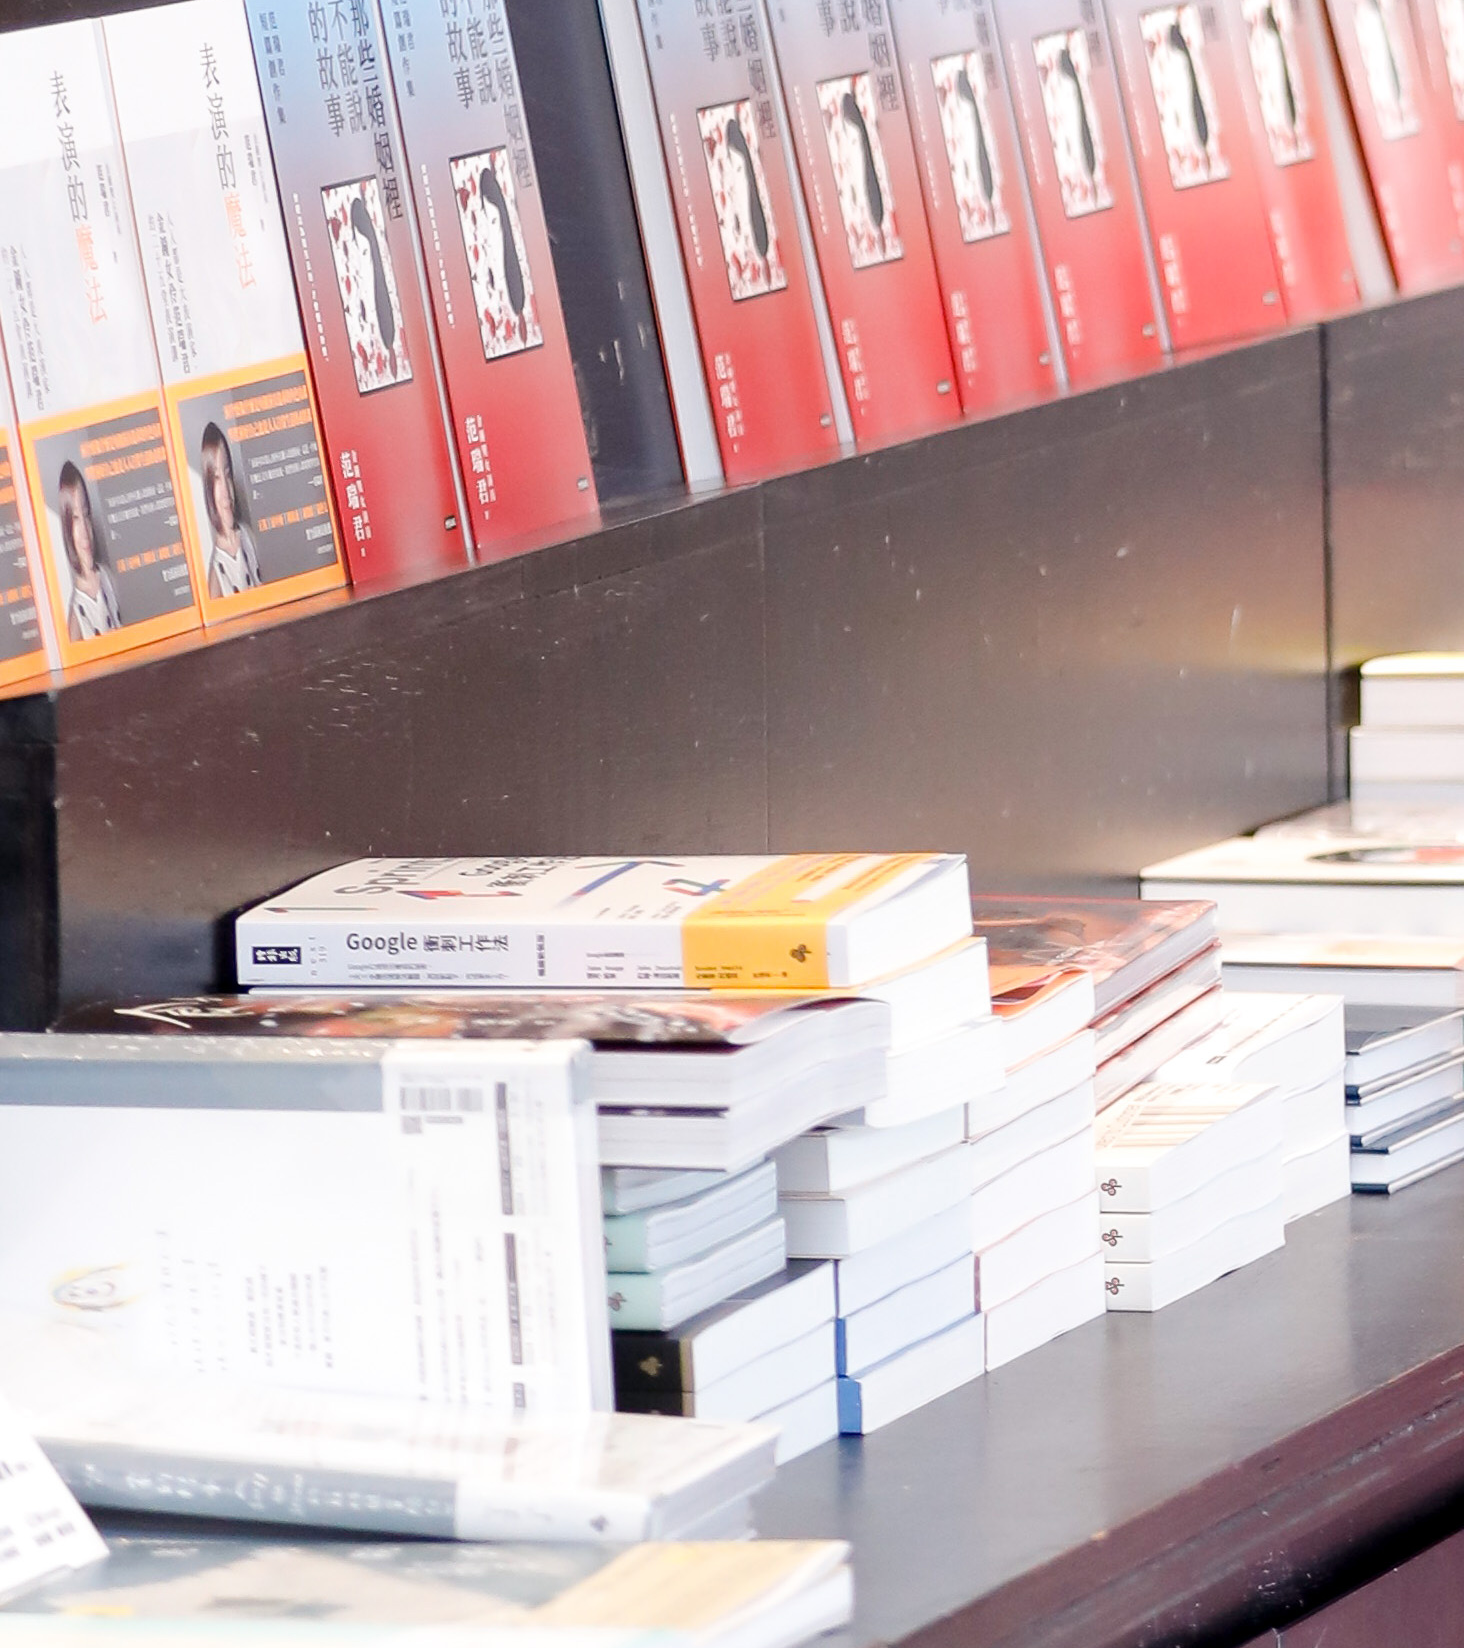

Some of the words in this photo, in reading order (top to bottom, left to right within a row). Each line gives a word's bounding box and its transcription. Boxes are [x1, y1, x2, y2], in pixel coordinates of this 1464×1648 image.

[307, 0, 346, 138] 的故事
[49, 70, 108, 326] 表演的魔法
[199, 42, 257, 290] 表演的魔法
[346, 932, 418, 955] Google
[423, 933, 511, 952] 衝刺工作法
